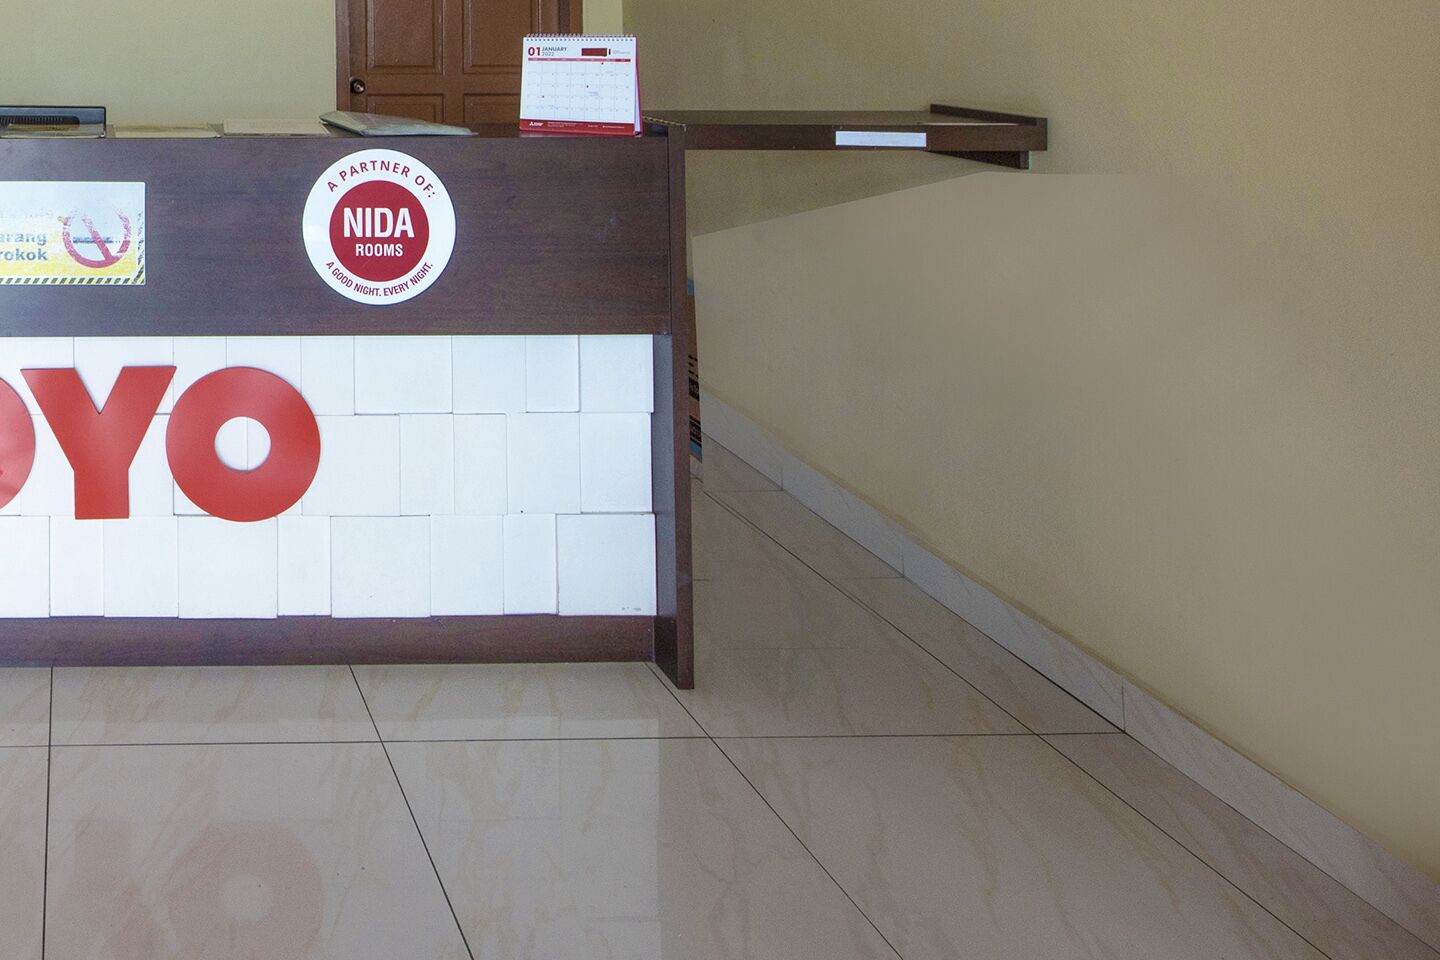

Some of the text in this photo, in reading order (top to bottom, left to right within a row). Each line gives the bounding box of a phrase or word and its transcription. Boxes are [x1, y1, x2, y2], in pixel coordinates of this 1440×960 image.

[528, 47, 541, 57] 01
[327, 160, 435, 198] A PARTNER OF:
[343, 207, 415, 238] NIDA
[355, 243, 404, 257] ROOMS
[326, 261, 434, 297] A GOOD NIGHT. EVERY NIGHT.
